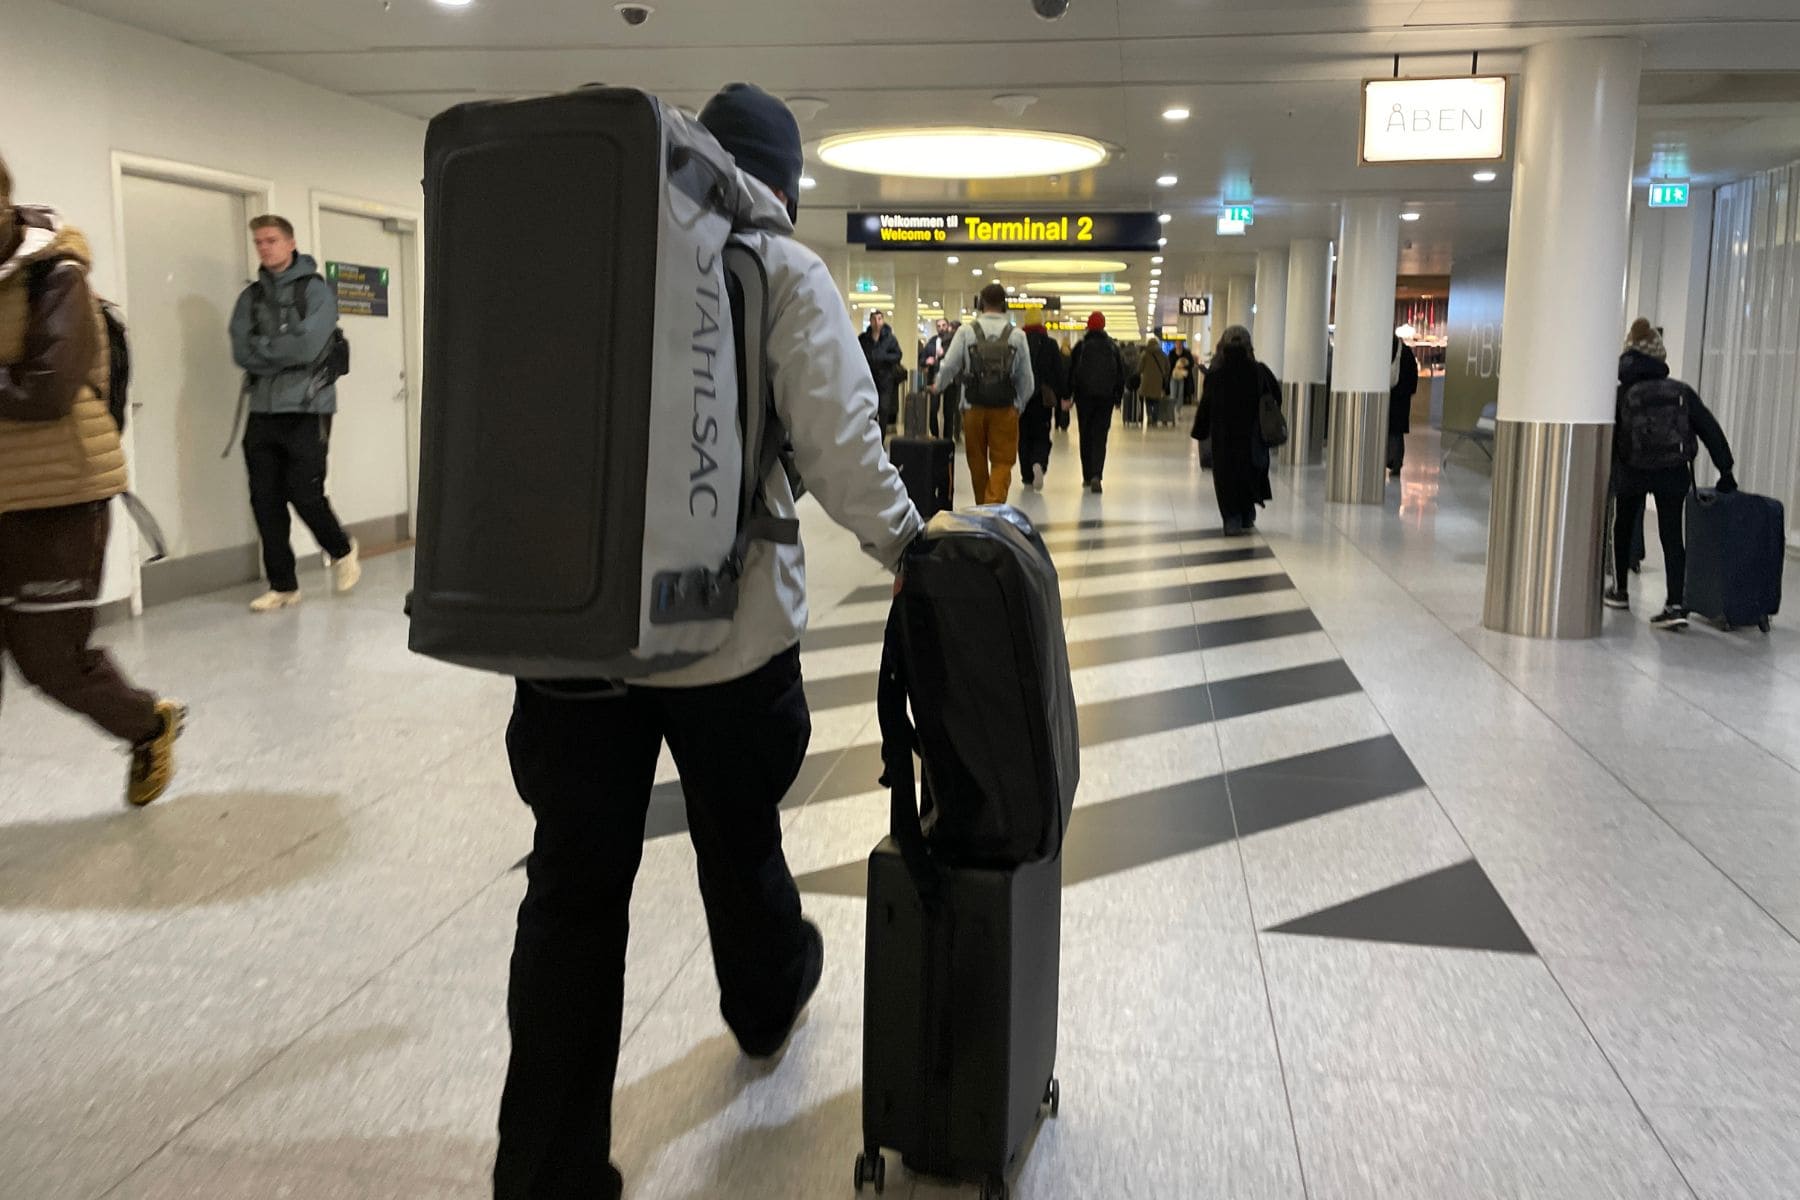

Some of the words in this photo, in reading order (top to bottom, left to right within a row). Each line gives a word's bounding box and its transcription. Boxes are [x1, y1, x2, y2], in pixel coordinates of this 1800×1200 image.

[1386, 103, 1483, 132] ÅBEN
[880, 214, 944, 228] Velkommen
[946, 214, 958, 228] til
[963, 216, 1068, 241] Terminal
[1077, 216, 1093, 241] 2
[880, 228, 931, 241] Welcome
[934, 228, 946, 241] to
